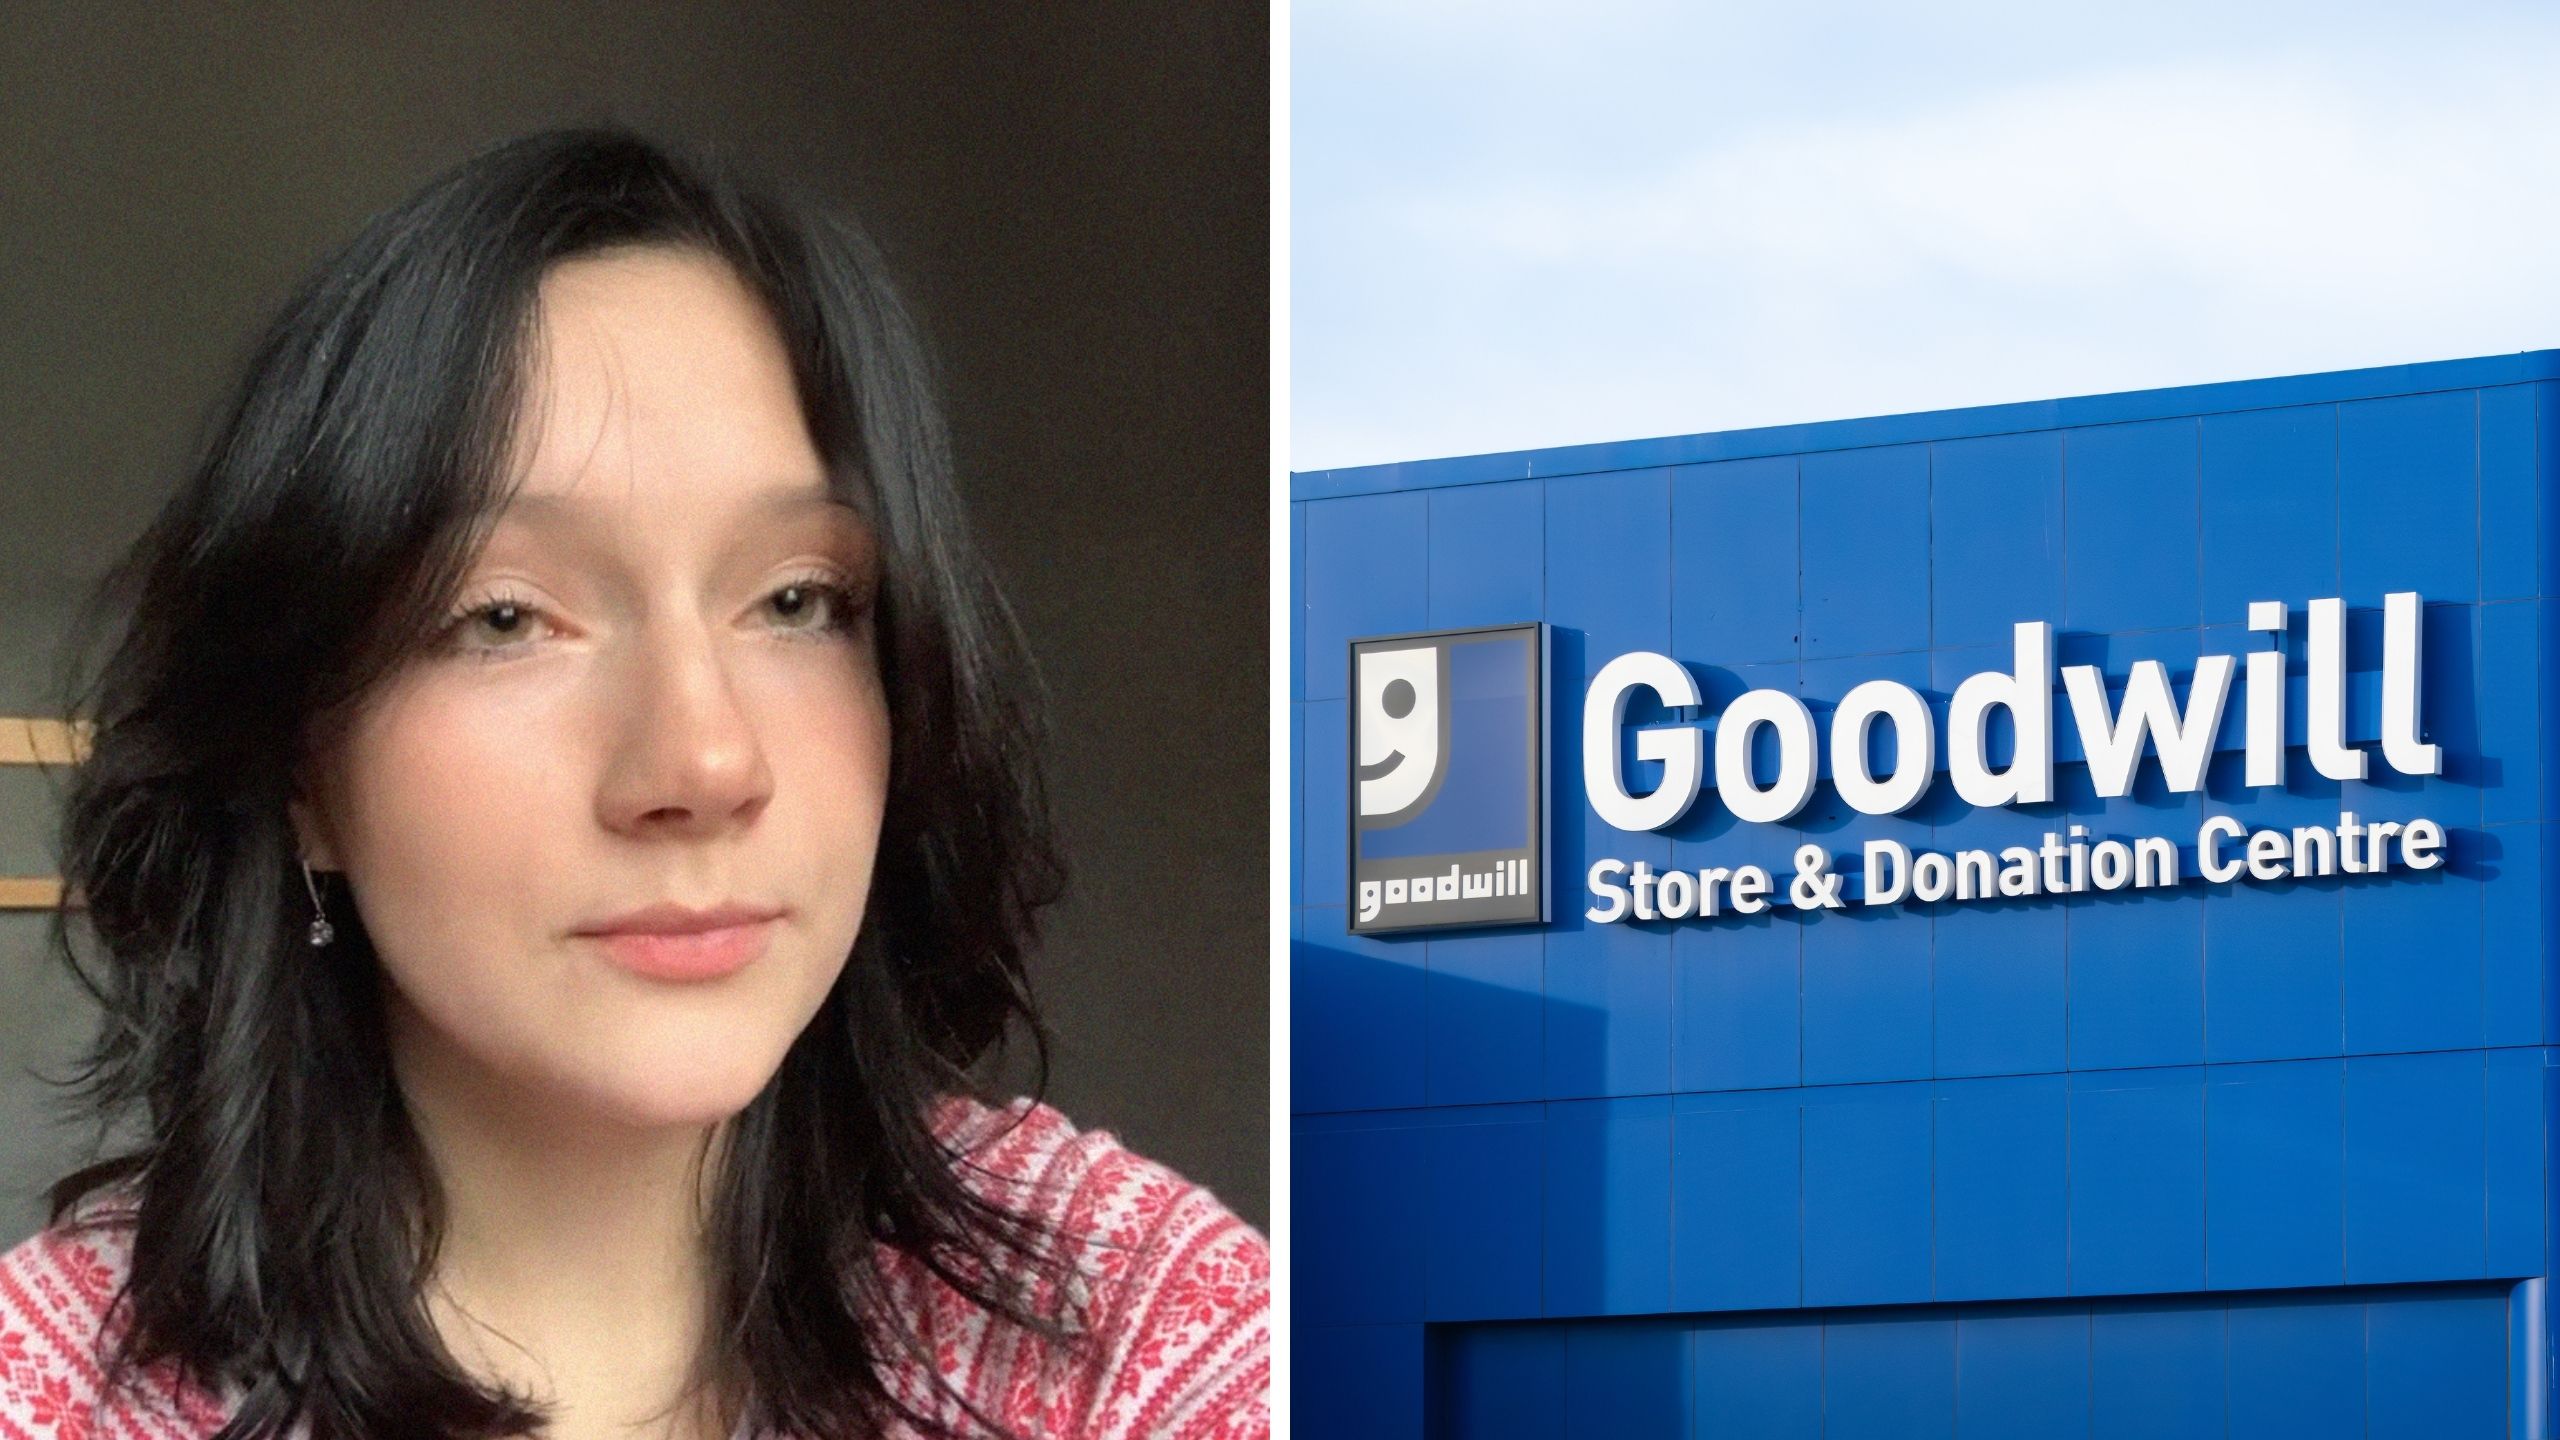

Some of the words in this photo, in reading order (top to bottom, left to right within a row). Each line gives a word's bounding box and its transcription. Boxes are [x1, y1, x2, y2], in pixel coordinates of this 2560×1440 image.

[1583, 591, 2443, 832] Goodwill
[1359, 858, 1529, 923] goodwill
[1585, 858, 1774, 924] Store
[1788, 843, 1847, 911] &
[1863, 825, 2180, 906] Donation
[2198, 811, 2447, 884] Centre
